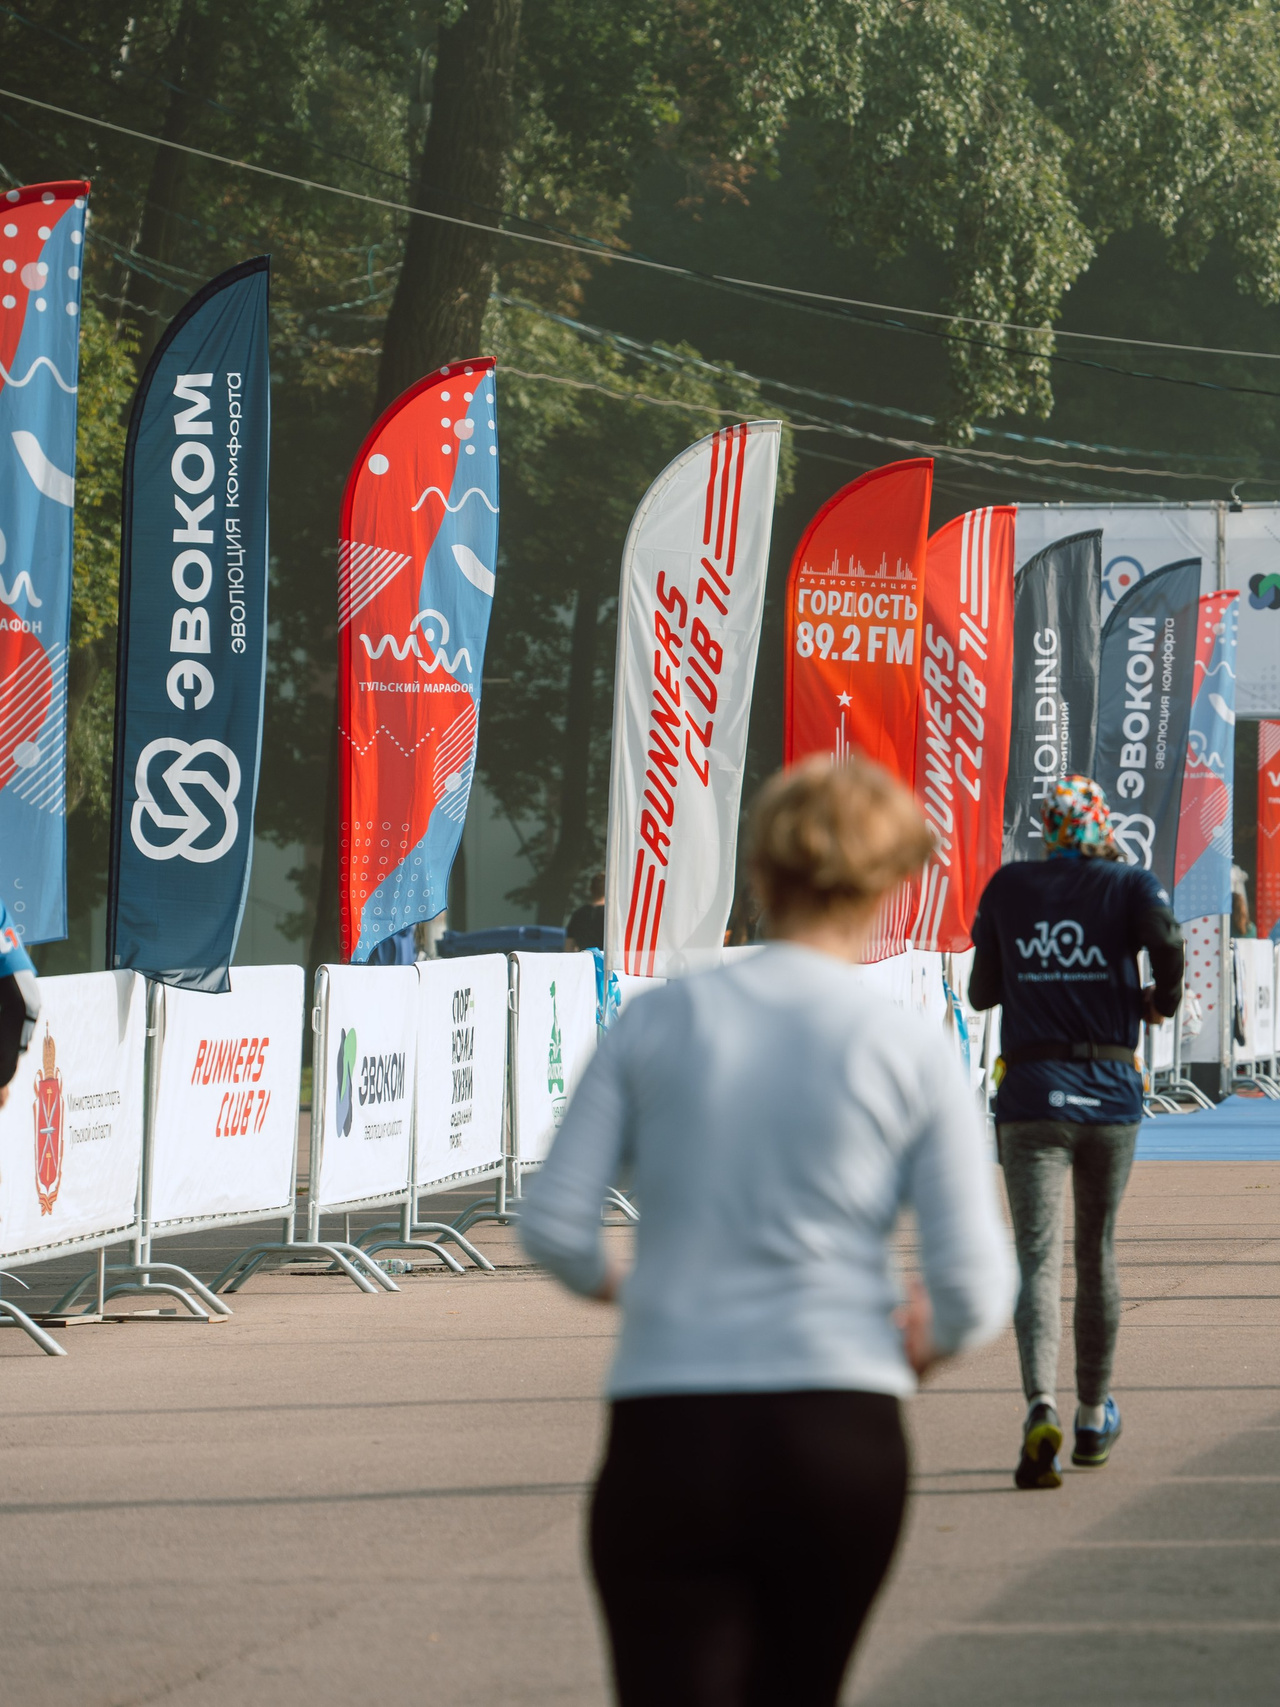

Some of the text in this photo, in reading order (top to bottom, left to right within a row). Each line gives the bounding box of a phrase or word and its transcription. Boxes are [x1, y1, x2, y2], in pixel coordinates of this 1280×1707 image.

[166, 372, 215, 711] ЭВОКОМ
[225, 372, 247, 654] эволюция комфорта
[796, 621, 915, 665] 89.2 FM
[798, 588, 918, 621] ГОРДОСТЬ
[799, 577, 918, 590] РАДИОСТАНЦИЯ
[359, 681, 474, 693] ТУЛЬСКИЙ МАРАФОН
[685, 557, 730, 788] CLUB 71
[955, 612, 988, 802] CLUB 71
[1032, 627, 1059, 799] HOLDING
[1116, 617, 1156, 800] ЭВОКОМ
[1161, 617, 1177, 692] комфорта
[641, 570, 687, 867] RUNNERS
[923, 623, 955, 867] RUNNERS
[191, 1037, 269, 1085] RUNNERS
[215, 1089, 271, 1137] CLUB 71
[358, 1052, 405, 1106] ЭВОКОМ
